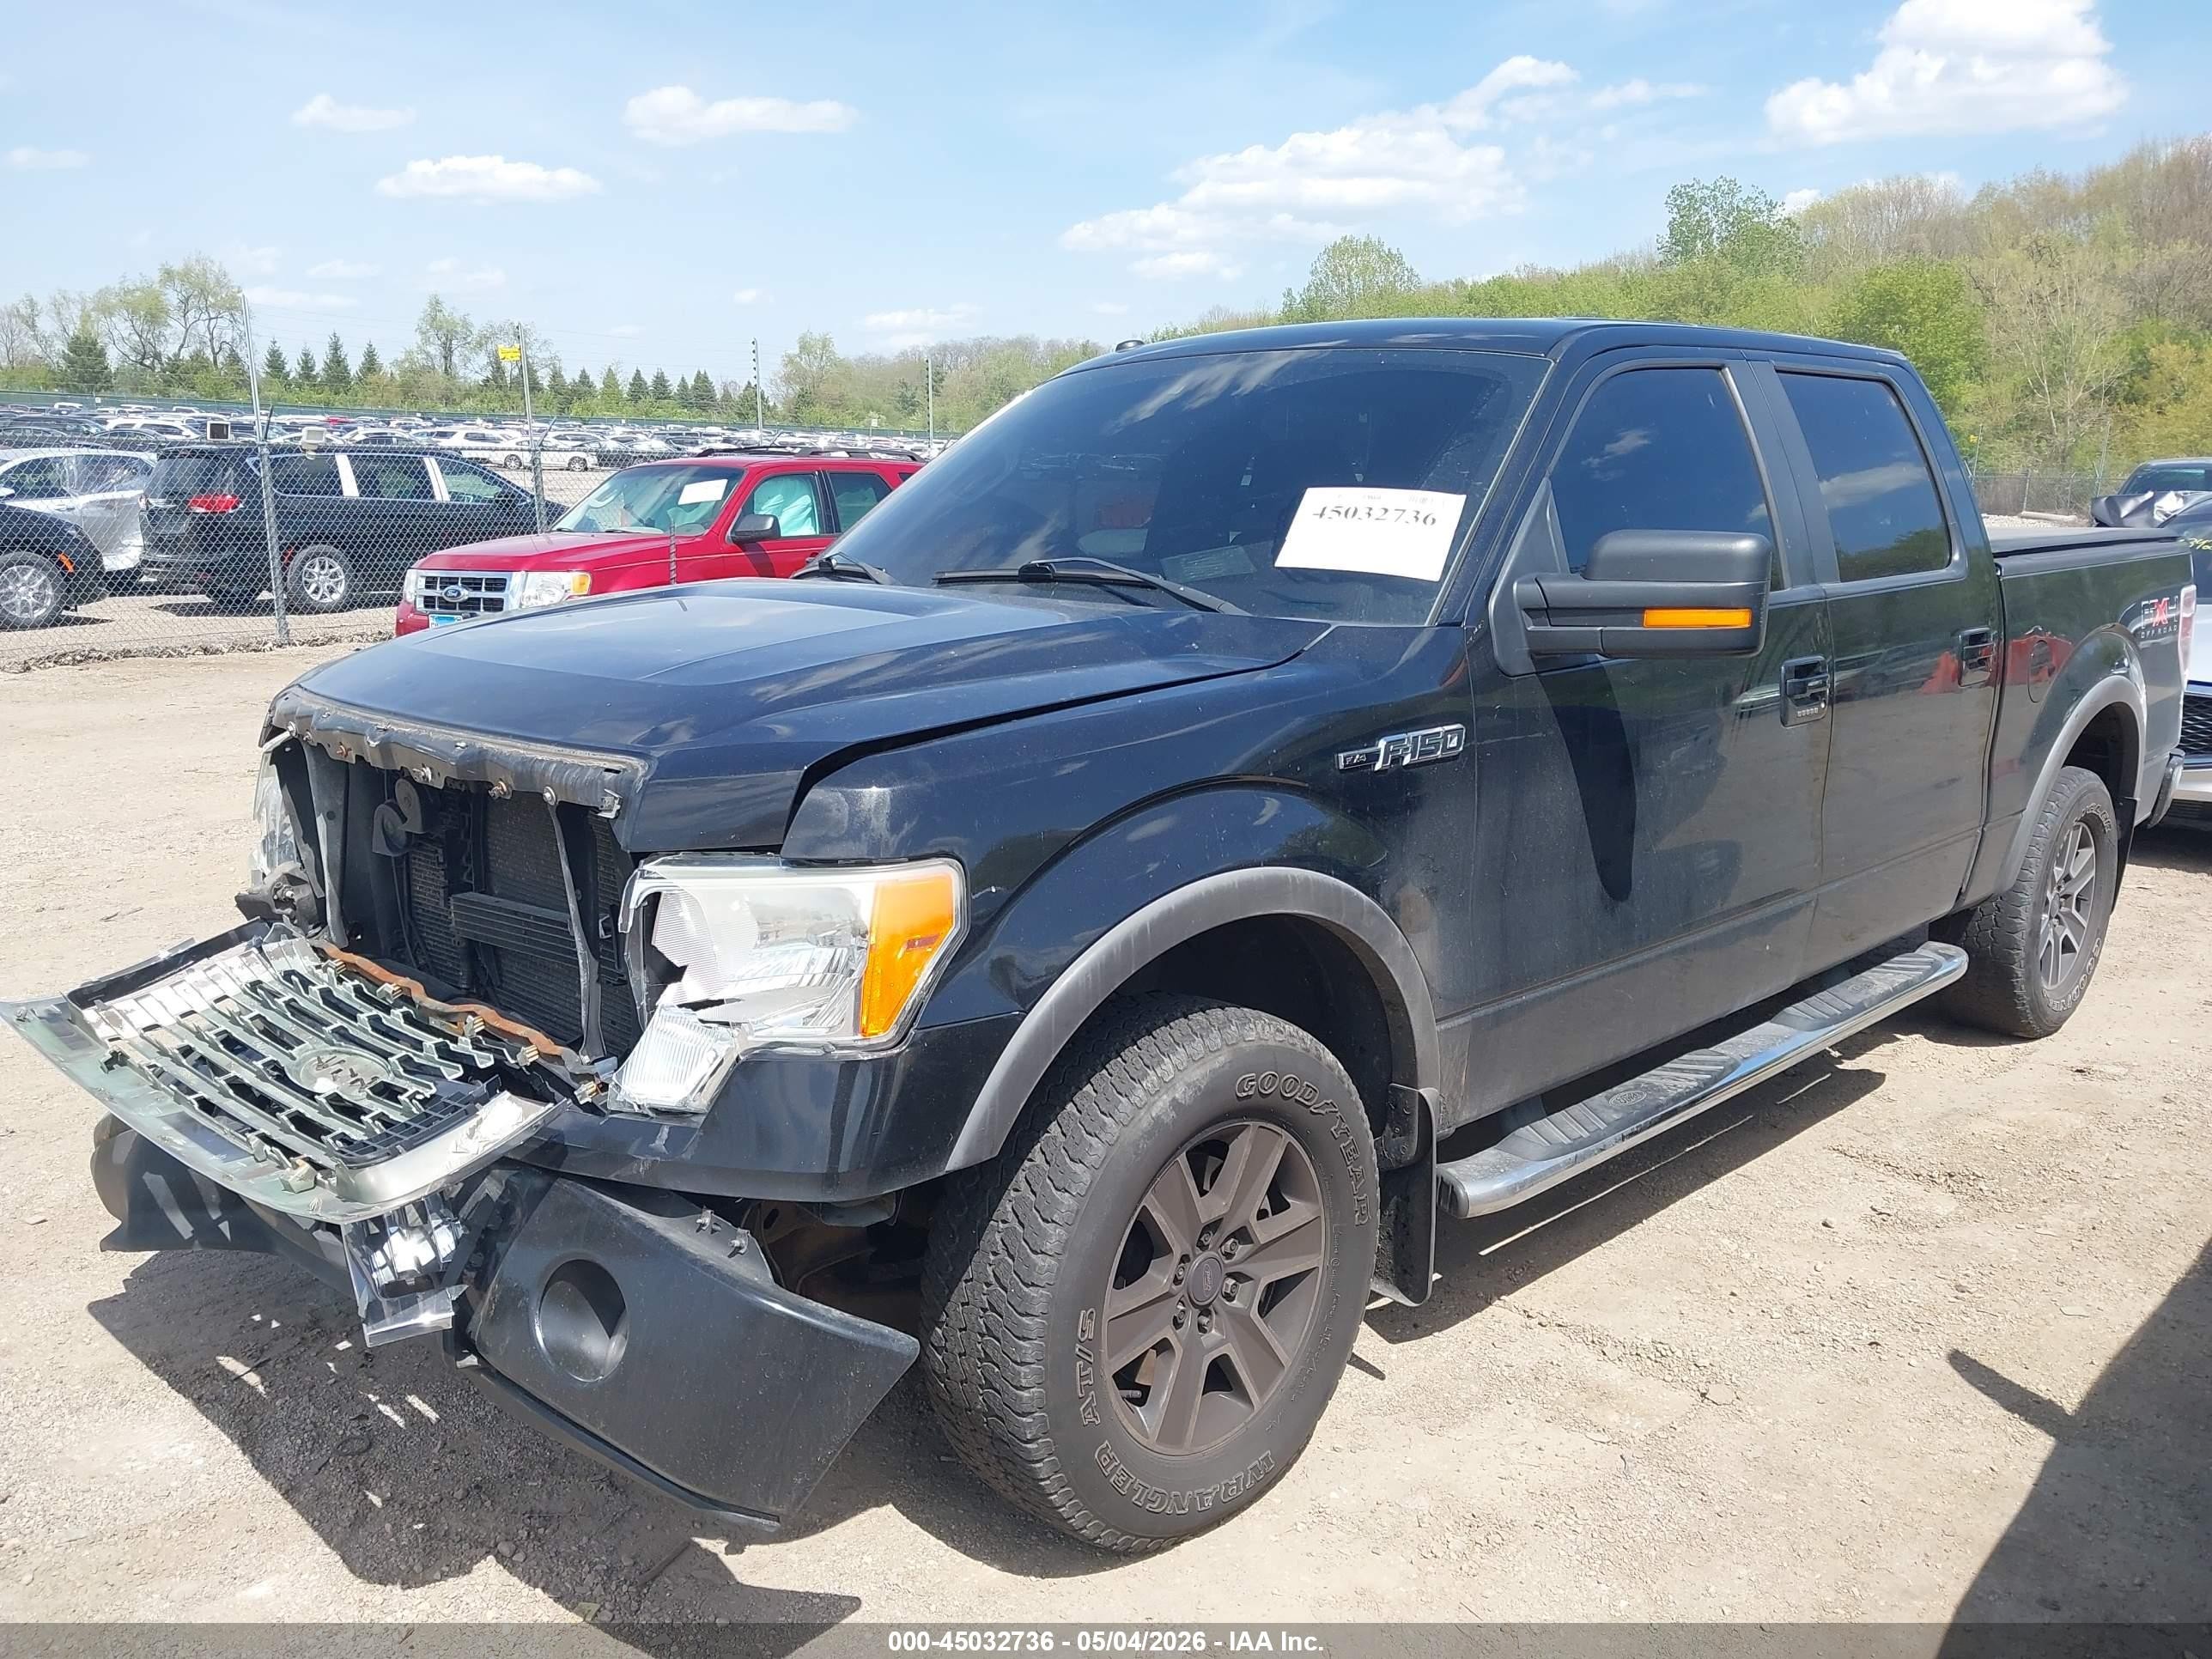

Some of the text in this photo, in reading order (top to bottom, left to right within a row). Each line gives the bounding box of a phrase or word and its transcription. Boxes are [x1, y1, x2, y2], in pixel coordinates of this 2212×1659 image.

[1311, 504, 1437, 527] 45032736
[2141, 595, 2179, 629] FX4
[2157, 624, 2179, 635] ROAD
[1235, 1070, 1372, 1227] GOODYEAR
[1075, 1307, 1277, 1515] WRANGLER AT/S
